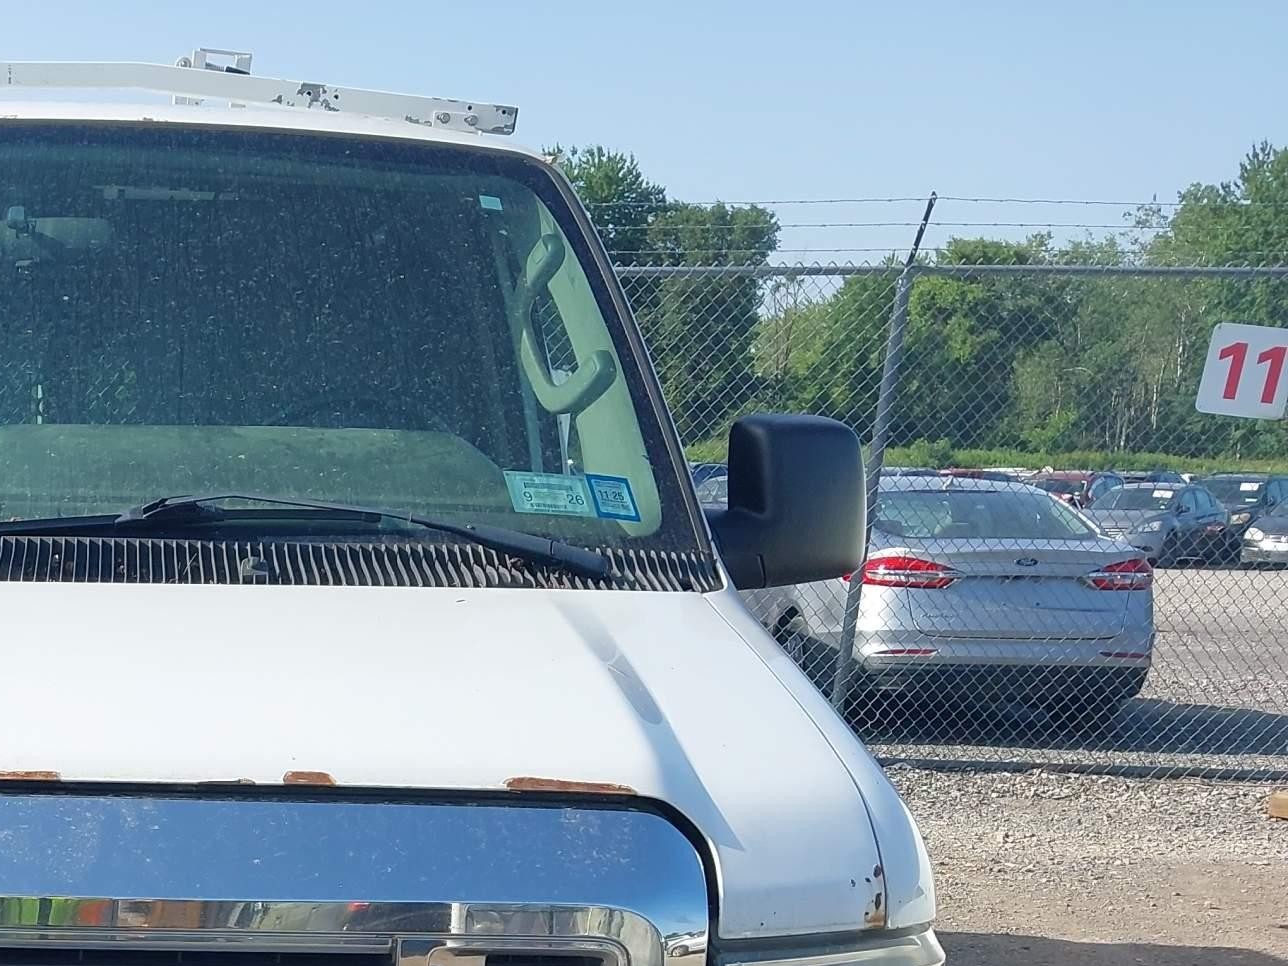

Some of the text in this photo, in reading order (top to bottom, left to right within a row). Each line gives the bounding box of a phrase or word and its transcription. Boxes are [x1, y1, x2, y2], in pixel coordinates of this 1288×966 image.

[1218, 342, 1288, 405] 11
[522, 491, 585, 506] 9 26
